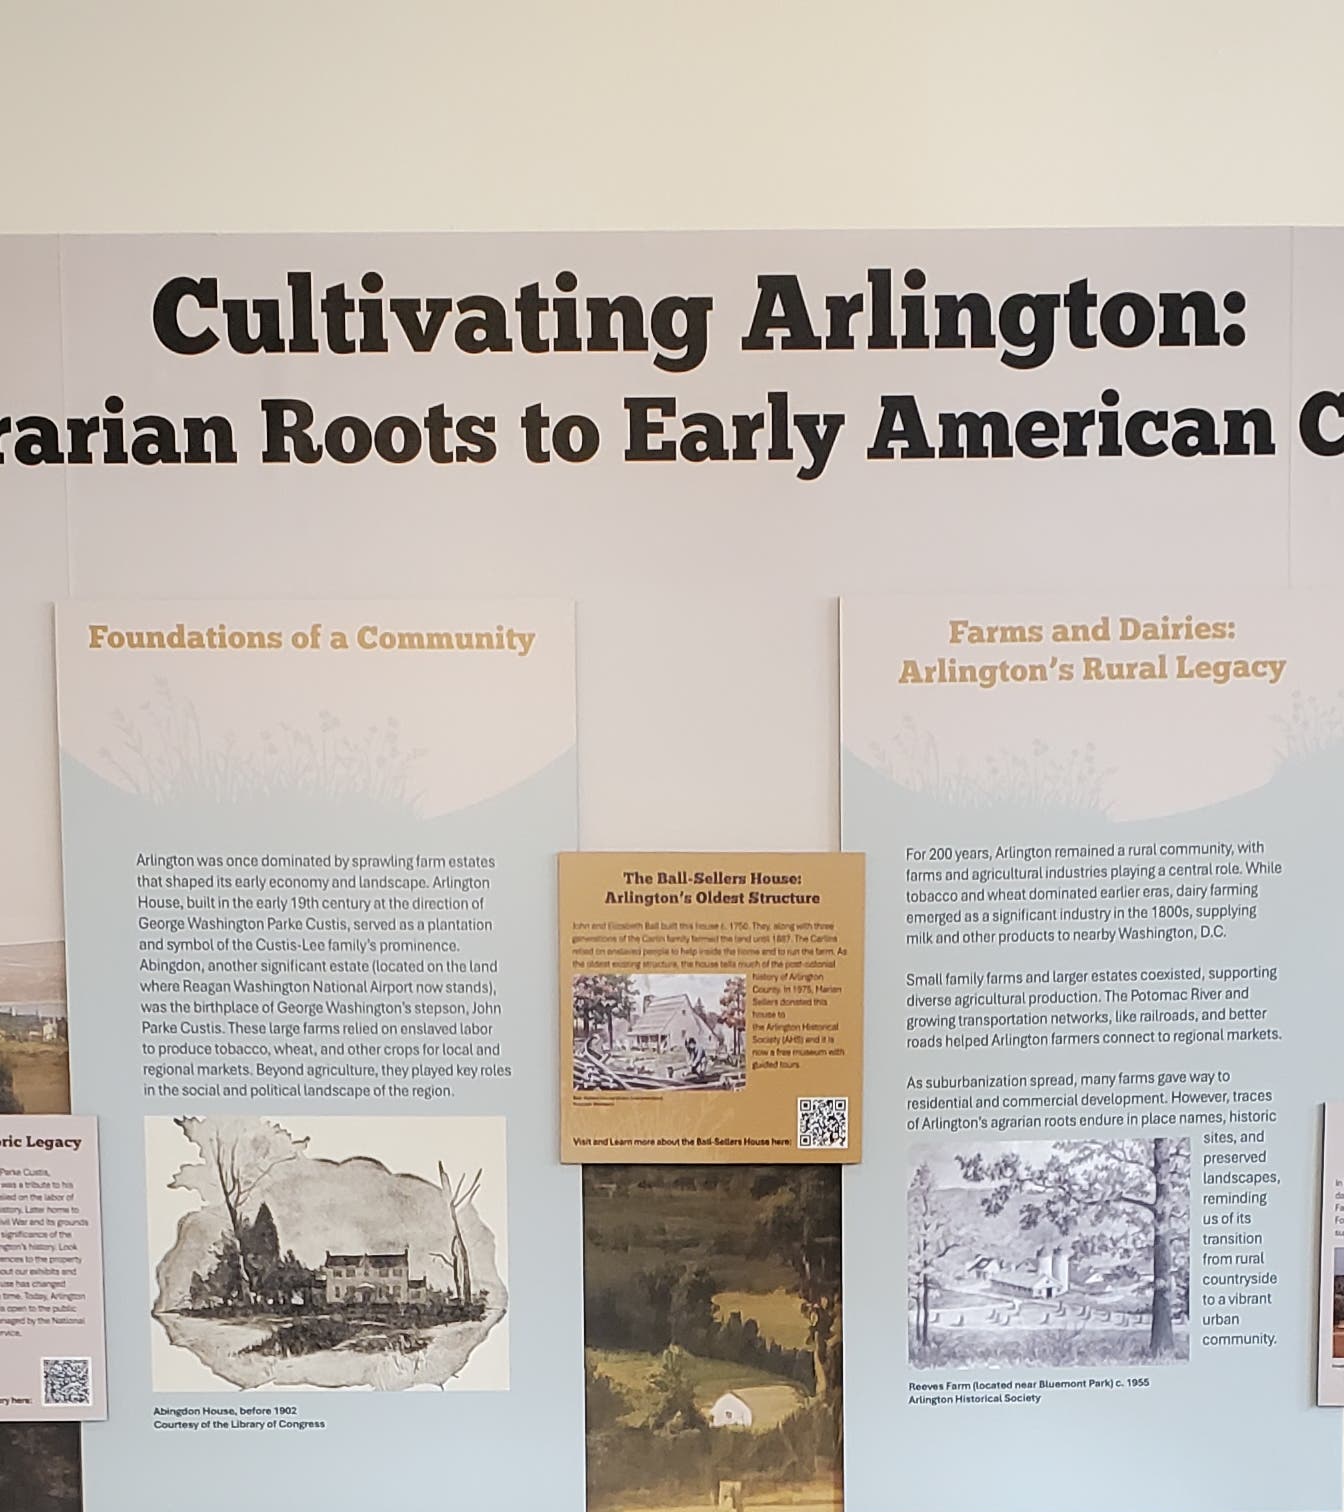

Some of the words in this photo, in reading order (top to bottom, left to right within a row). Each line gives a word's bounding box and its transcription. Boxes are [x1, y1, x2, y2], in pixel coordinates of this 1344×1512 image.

[152, 273, 713, 370] Cultivating
[741, 270, 1245, 367] Arlington:
[260, 399, 496, 463] Roots
[520, 404, 599, 463] to
[624, 392, 845, 478] Early
[866, 392, 1275, 458] American
[949, 620, 1042, 643] Farms
[1052, 617, 1110, 642] and
[1119, 615, 1234, 640] Dairies:
[89, 624, 282, 648] Foundations
[291, 624, 321, 649] of
[330, 632, 348, 649] a
[357, 626, 535, 655] Community
[898, 657, 1073, 687] Arlington's
[1082, 655, 1167, 680] Rural
[1176, 656, 1286, 684] Legacy
[906, 847, 926, 860] For
[929, 847, 952, 860] 200
[955, 849, 992, 862] years,
[995, 846, 1051, 861] Arlington
[1055, 844, 1114, 857] remained
[1117, 846, 1124, 856] a
[1128, 843, 1156, 856] rural
[1159, 842, 1234, 856] community,
[1237, 840, 1264, 853] with
[136, 853, 194, 869] Arlington
[196, 857, 223, 866] was
[226, 857, 258, 867] once
[261, 854, 330, 867] dominated
[334, 854, 349, 870] by
[352, 855, 413, 870] sprawling
[416, 854, 445, 867] farm
[448, 856, 495, 868] estates
[623, 871, 652, 884] The
[657, 871, 746, 884] Ball-Sellers
[750, 872, 801, 884] House:
[605, 891, 691, 906] Arlington's
[696, 891, 744, 904] Oldest
[748, 891, 819, 904] Structure
[26, 1136, 81, 1151] Legacy
[909, 1382, 943, 1390] Reeves
[946, 1381, 970, 1390] Farm
[972, 1381, 1012, 1391] (located
[1039, 1380, 1086, 1388] Bluemont
[1088, 1379, 1113, 1388] Park)
[1127, 1378, 1149, 1386] 1955
[908, 1395, 953, 1405] Arlington
[955, 1394, 1002, 1403] Historical
[1004, 1393, 1041, 1403] Society
[153, 1407, 200, 1417] Abingdon
[239, 1406, 271, 1415] before
[273, 1406, 296, 1414] 1902
[153, 1420, 199, 1429] Courtesy
[200, 1420, 210, 1428] of
[212, 1420, 228, 1428] the
[231, 1420, 264, 1429] Library
[266, 1420, 276, 1428] of
[278, 1420, 324, 1429] Congress
